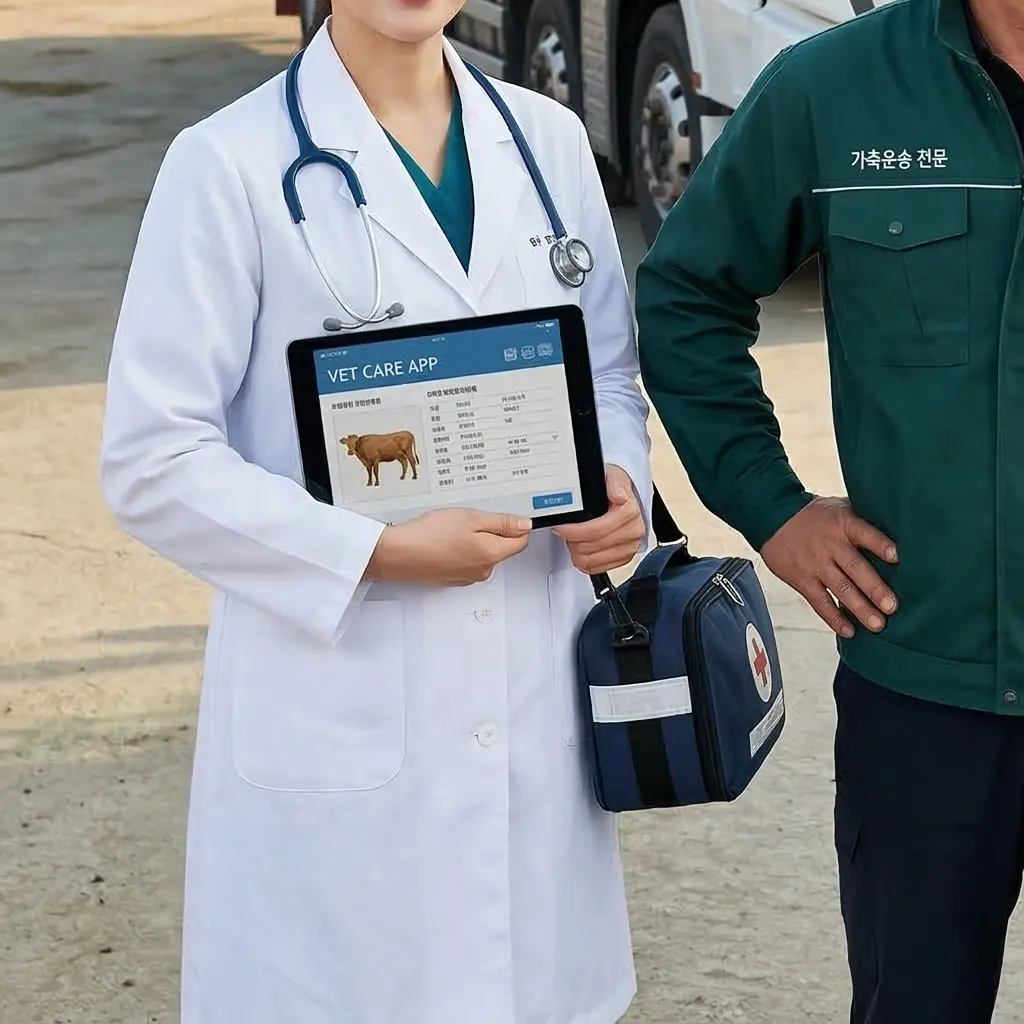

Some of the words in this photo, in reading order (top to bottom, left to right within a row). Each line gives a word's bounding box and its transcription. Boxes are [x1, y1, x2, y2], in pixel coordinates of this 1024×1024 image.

[850, 148, 913, 170] 가축운송
[327, 366, 359, 384] VET
[362, 360, 405, 379] CARE
[408, 356, 439, 374] APP
